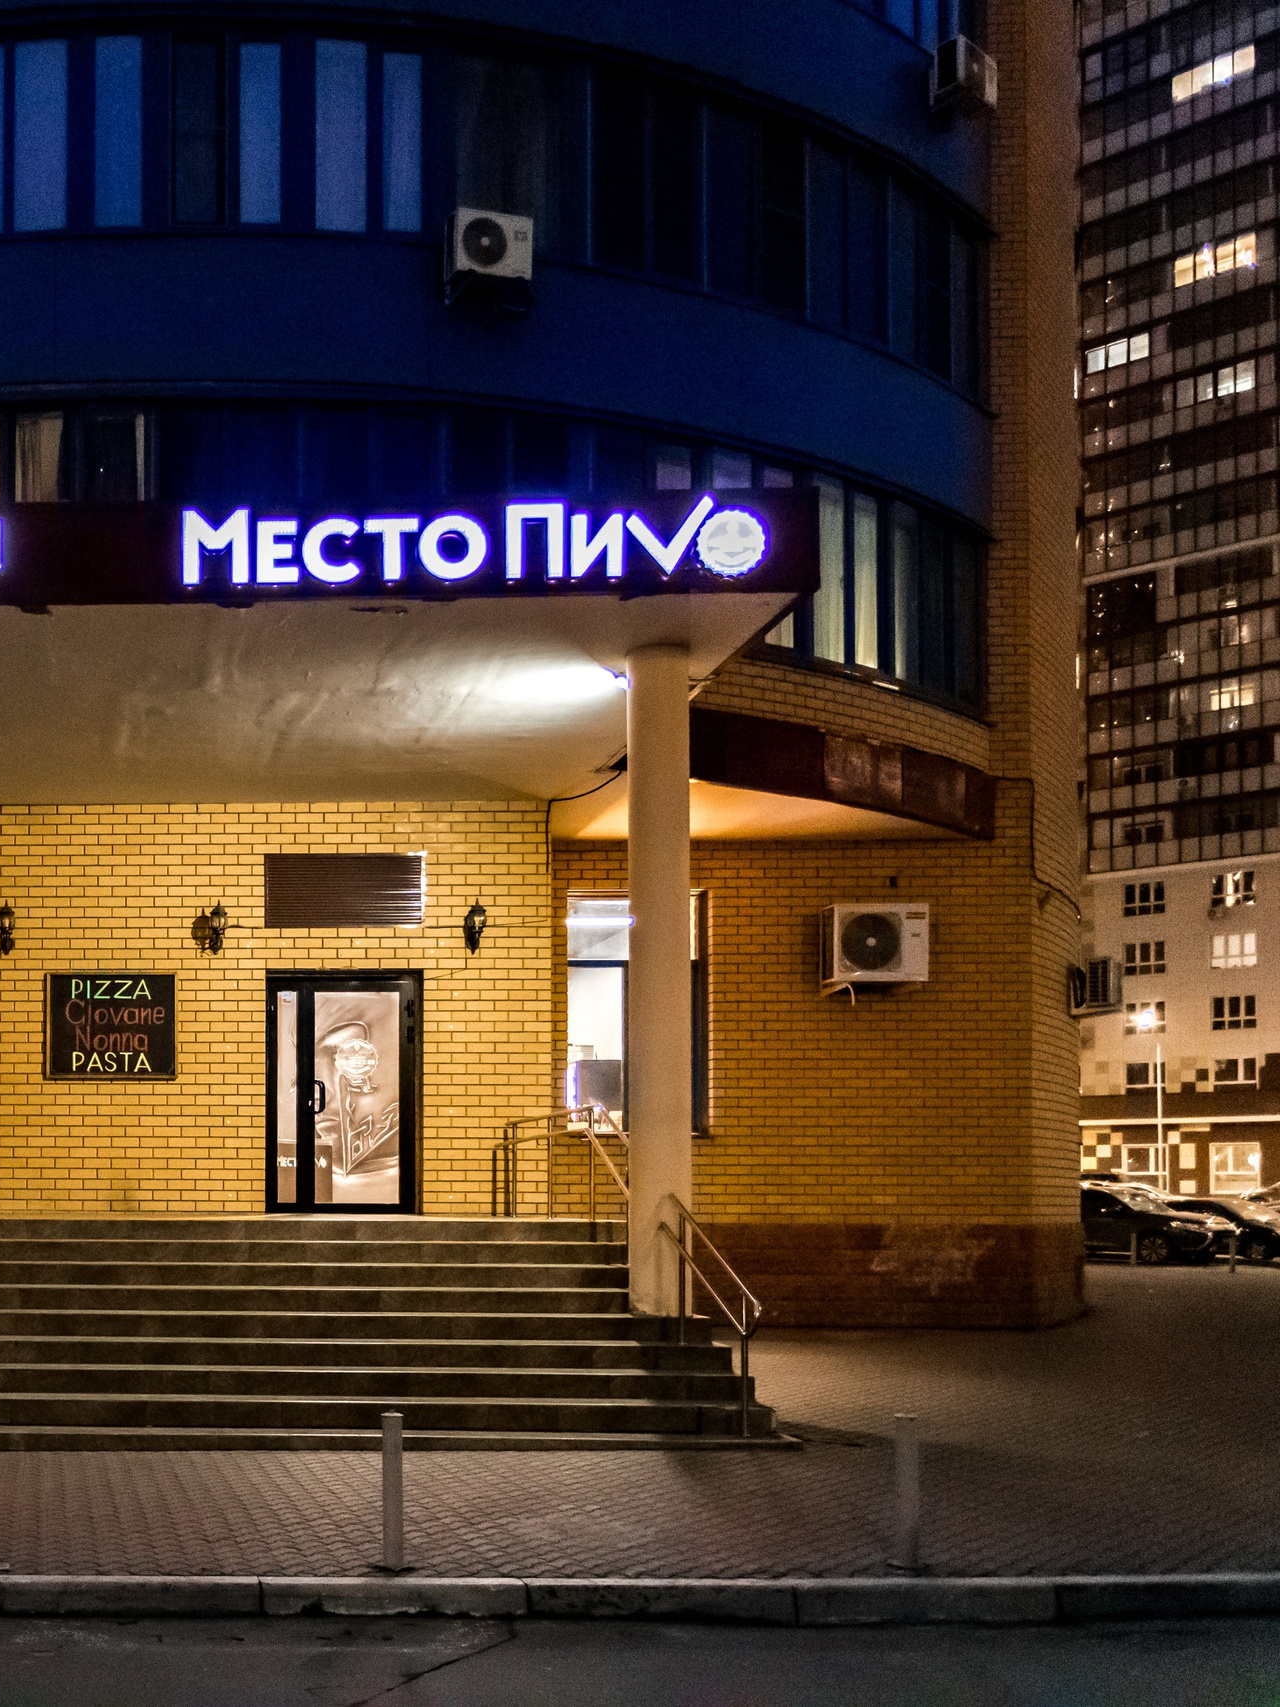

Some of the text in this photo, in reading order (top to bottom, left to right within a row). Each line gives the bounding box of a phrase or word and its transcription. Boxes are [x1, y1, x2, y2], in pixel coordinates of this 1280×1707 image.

[71, 979, 151, 1000] PIZZA
[75, 1024, 148, 1051] Nonna
[72, 1051, 152, 1072] PASTA
